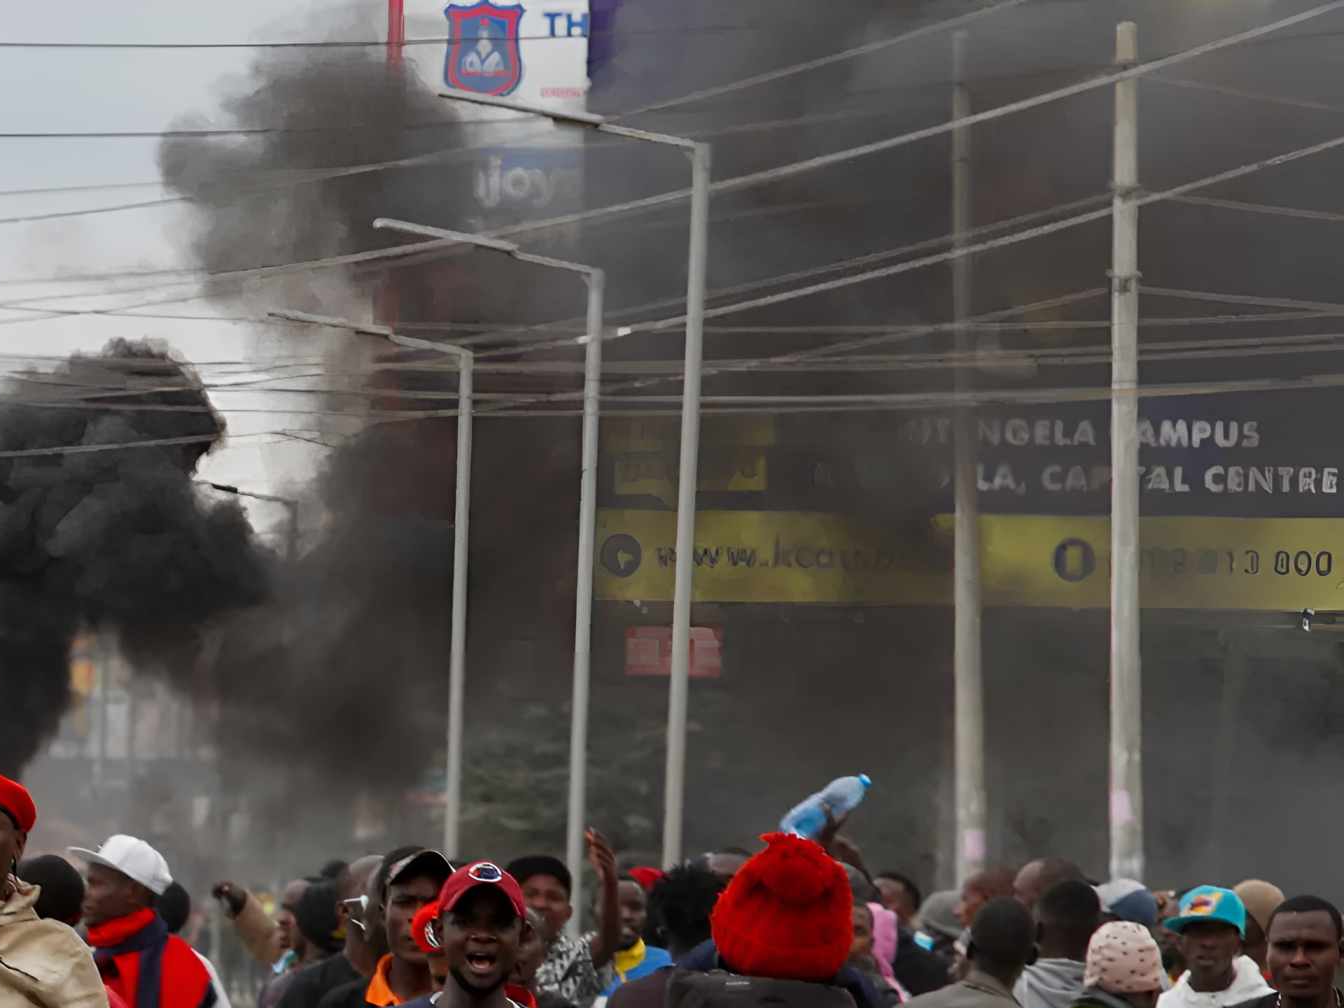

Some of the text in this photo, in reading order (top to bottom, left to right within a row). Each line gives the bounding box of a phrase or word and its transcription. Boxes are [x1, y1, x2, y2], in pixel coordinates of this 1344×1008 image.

[1137, 418, 1260, 448] AMPUS
[1204, 464, 1339, 494] CENTRE
[1273, 550, 1333, 577] 000
